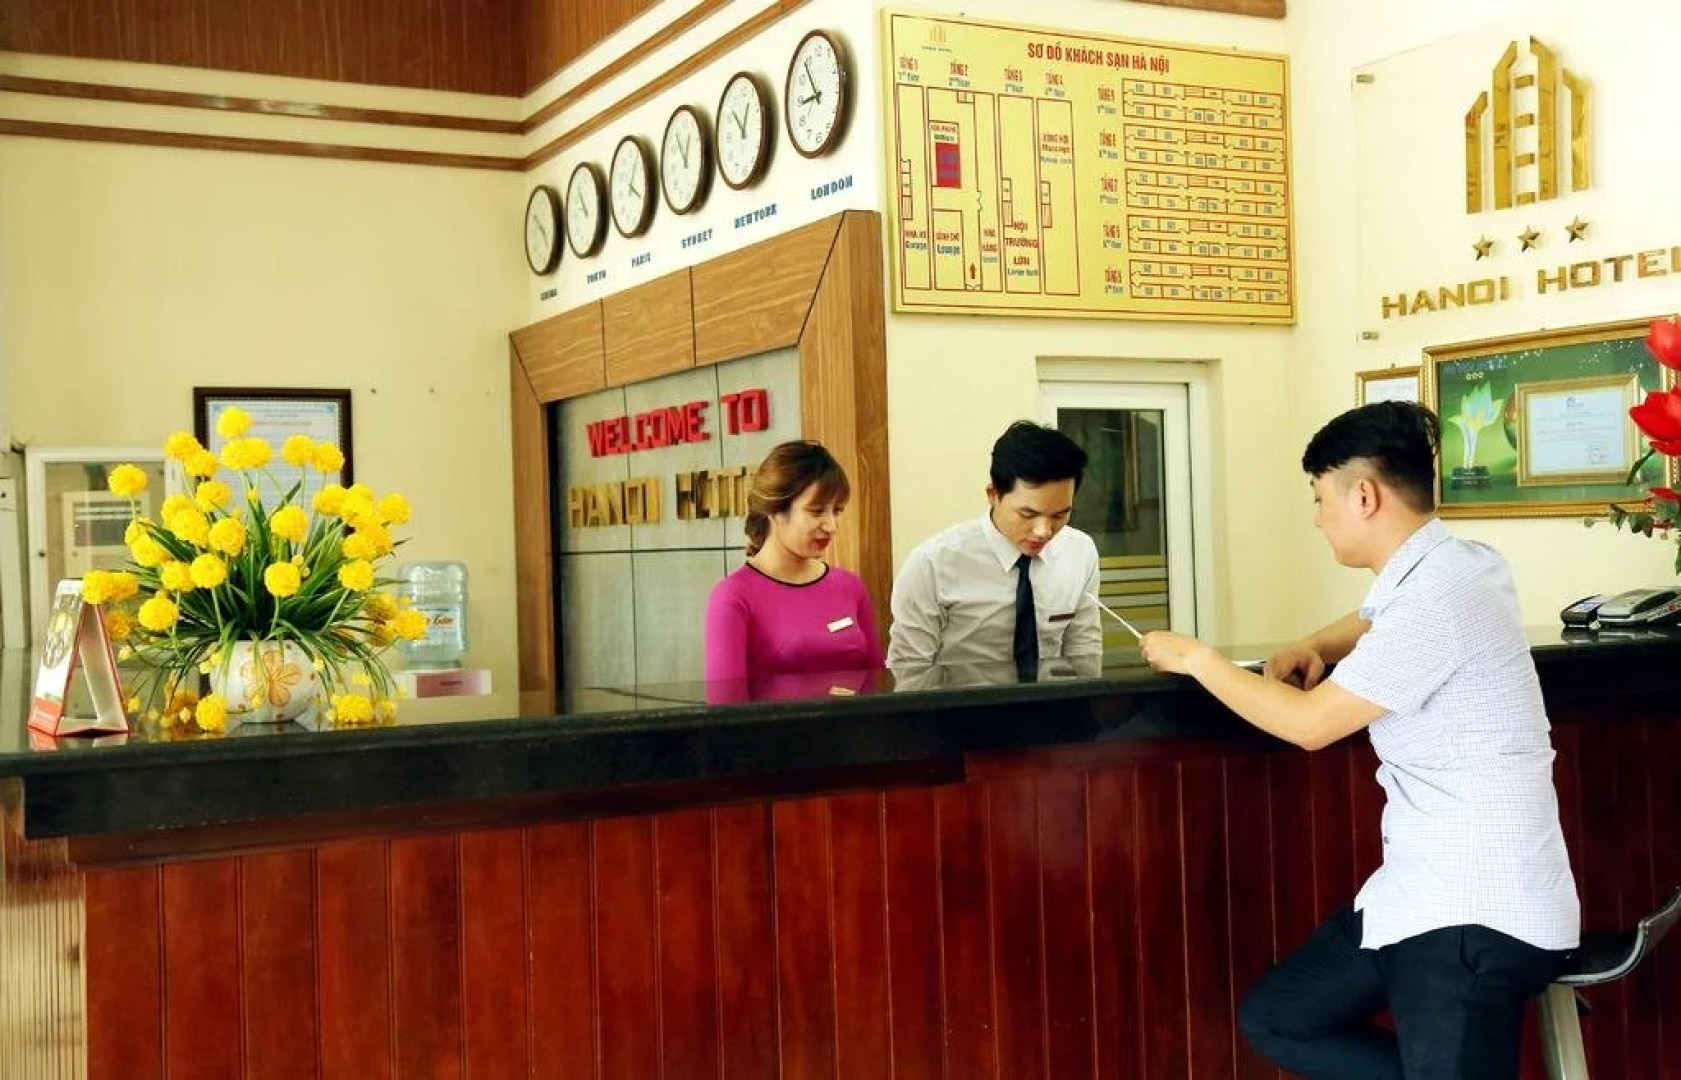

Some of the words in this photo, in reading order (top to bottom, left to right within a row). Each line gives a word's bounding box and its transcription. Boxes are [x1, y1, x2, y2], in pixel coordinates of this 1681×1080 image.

[1027, 42, 1044, 58] SƠ
[1046, 41, 1063, 60] ĐỒ
[1065, 44, 1104, 65] KHÁCH
[1106, 52, 1129, 71] SẠN
[1132, 52, 1147, 70] HÀ
[1150, 55, 1170, 75] NỘI
[810, 175, 853, 200] LONDON
[1381, 275, 1509, 319] HANOI
[586, 401, 711, 458] WELCOME
[719, 388, 770, 436] TO
[569, 477, 661, 528] HANOI
[675, 466, 758, 521] HOT
